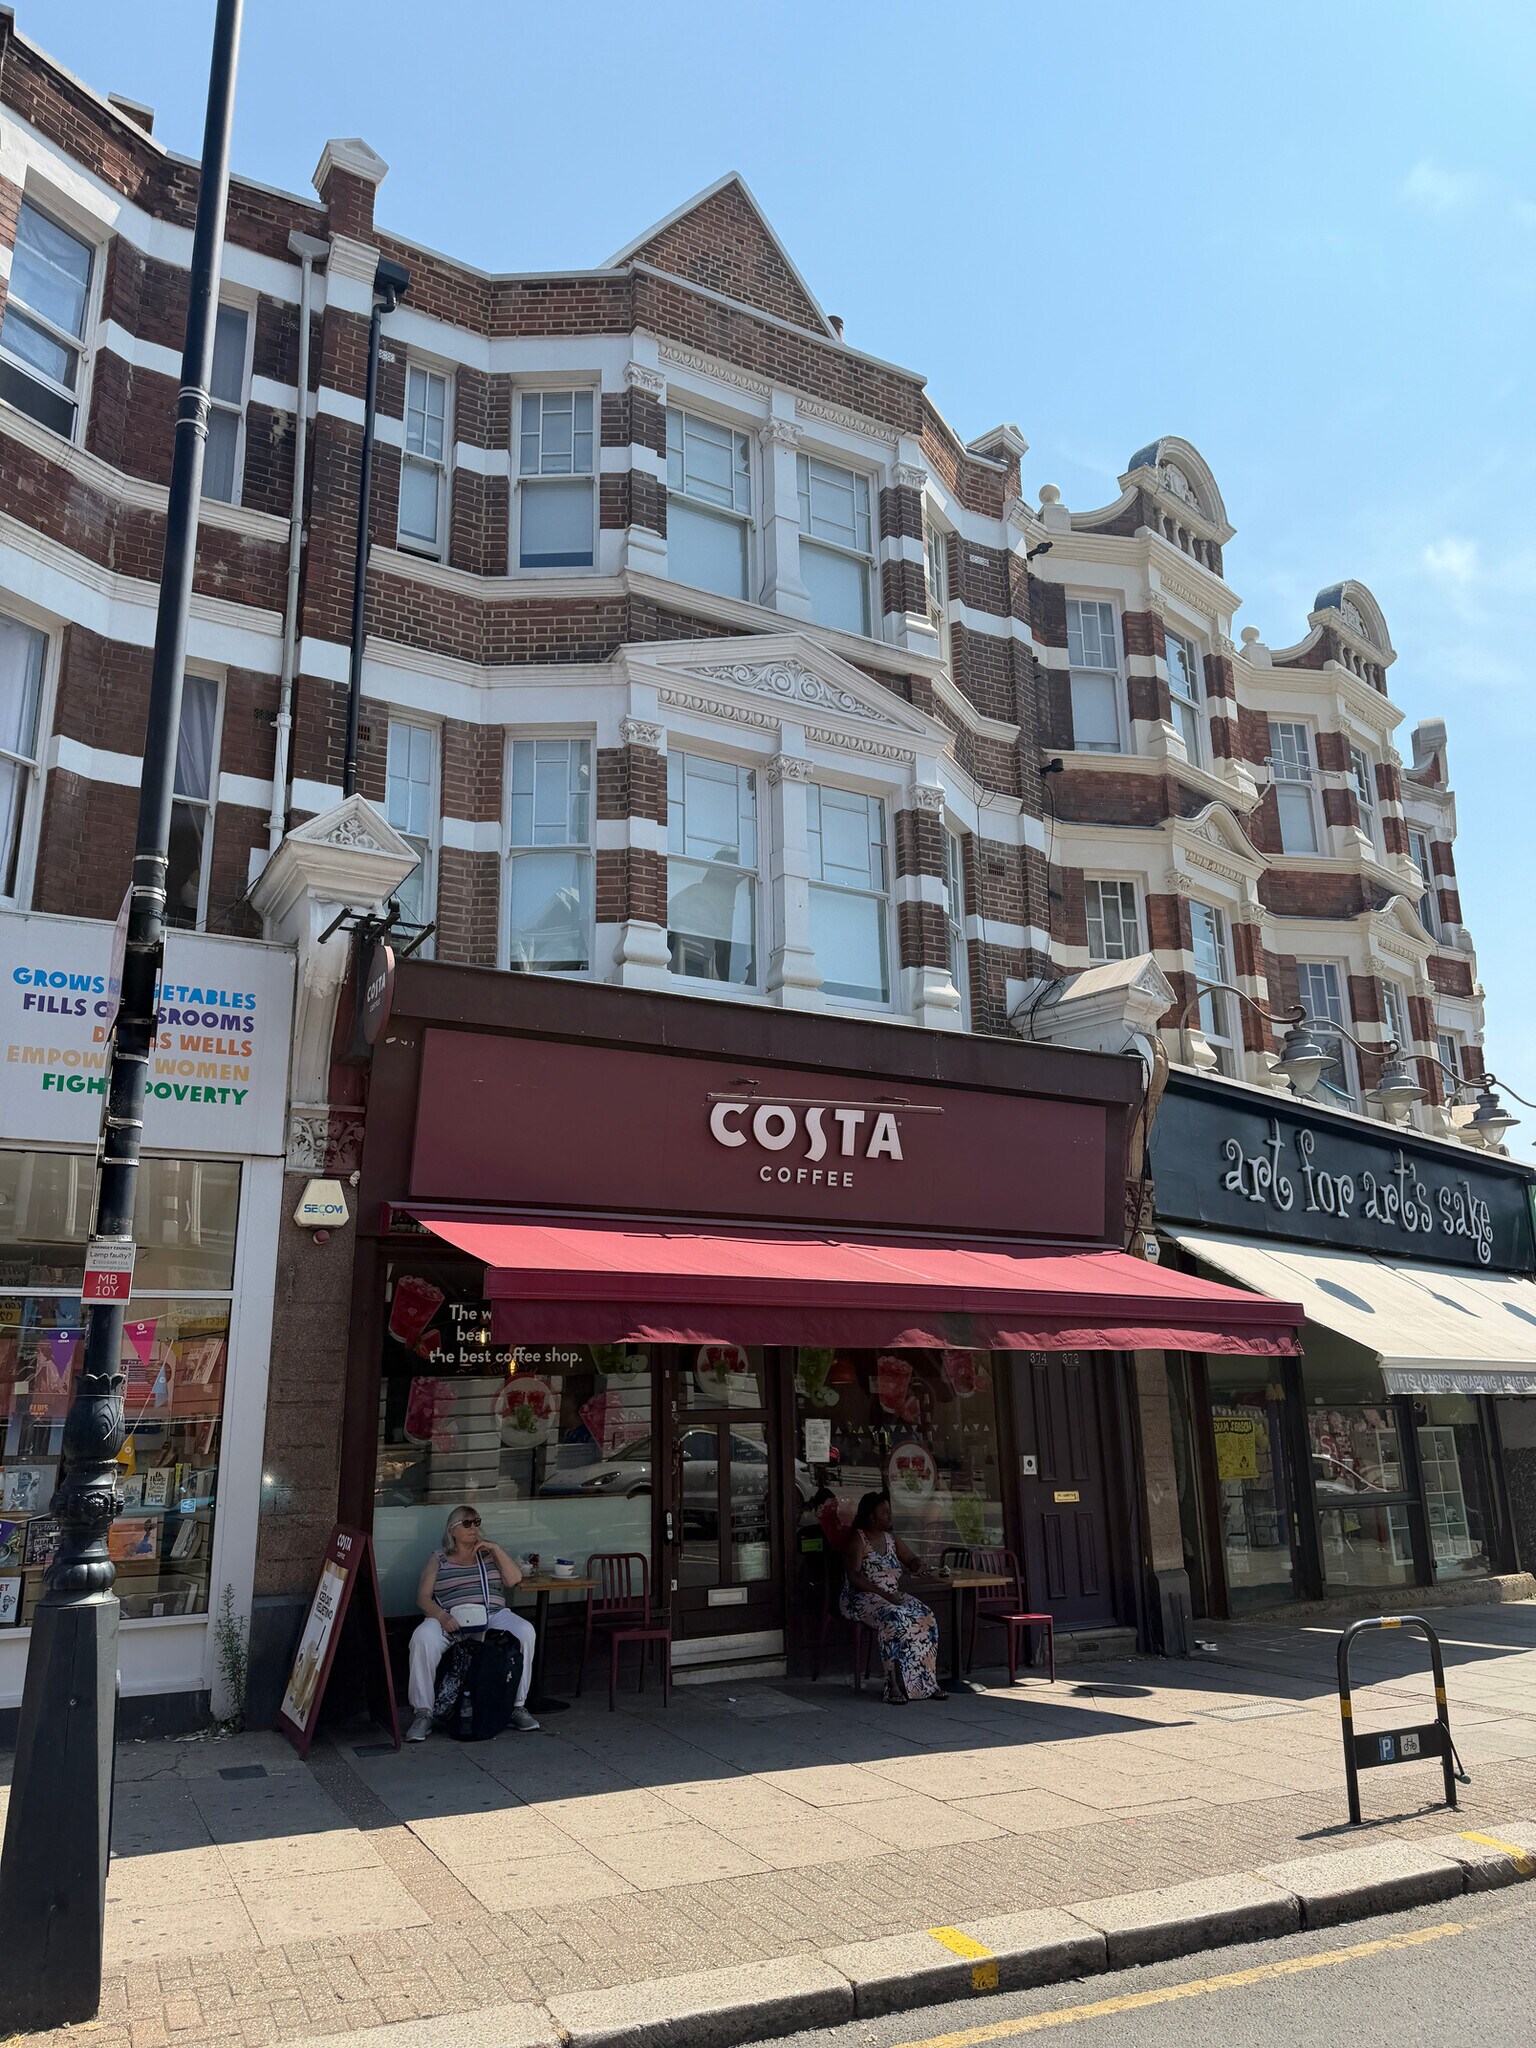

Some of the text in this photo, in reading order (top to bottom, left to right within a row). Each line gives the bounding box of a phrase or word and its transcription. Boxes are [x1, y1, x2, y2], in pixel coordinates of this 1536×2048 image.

[13, 967, 105, 994] GROWS
[367, 972, 386, 1003] COSTA
[23, 993, 254, 1033] FILLS CSROOMS
[180, 1034, 252, 1057] WELLS
[7, 1045, 249, 1081] EMPOW WOMEN
[710, 1102, 904, 1162] COSTA
[759, 1165, 854, 1188] COFFEE
[1225, 1117, 1494, 1265] art for art's sake
[303, 1203, 343, 1214] SECOM
[109, 1252, 132, 1260] faulty?
[97, 1274, 118, 1285] MB
[95, 1285, 120, 1296] 10Y
[449, 1305, 478, 1321] The
[429, 1346, 583, 1367] the best coffee shop.
[1030, 1352, 1079, 1364] 374 372
[337, 1533, 353, 1552] COSTA
[1381, 1738, 1392, 1758] P
